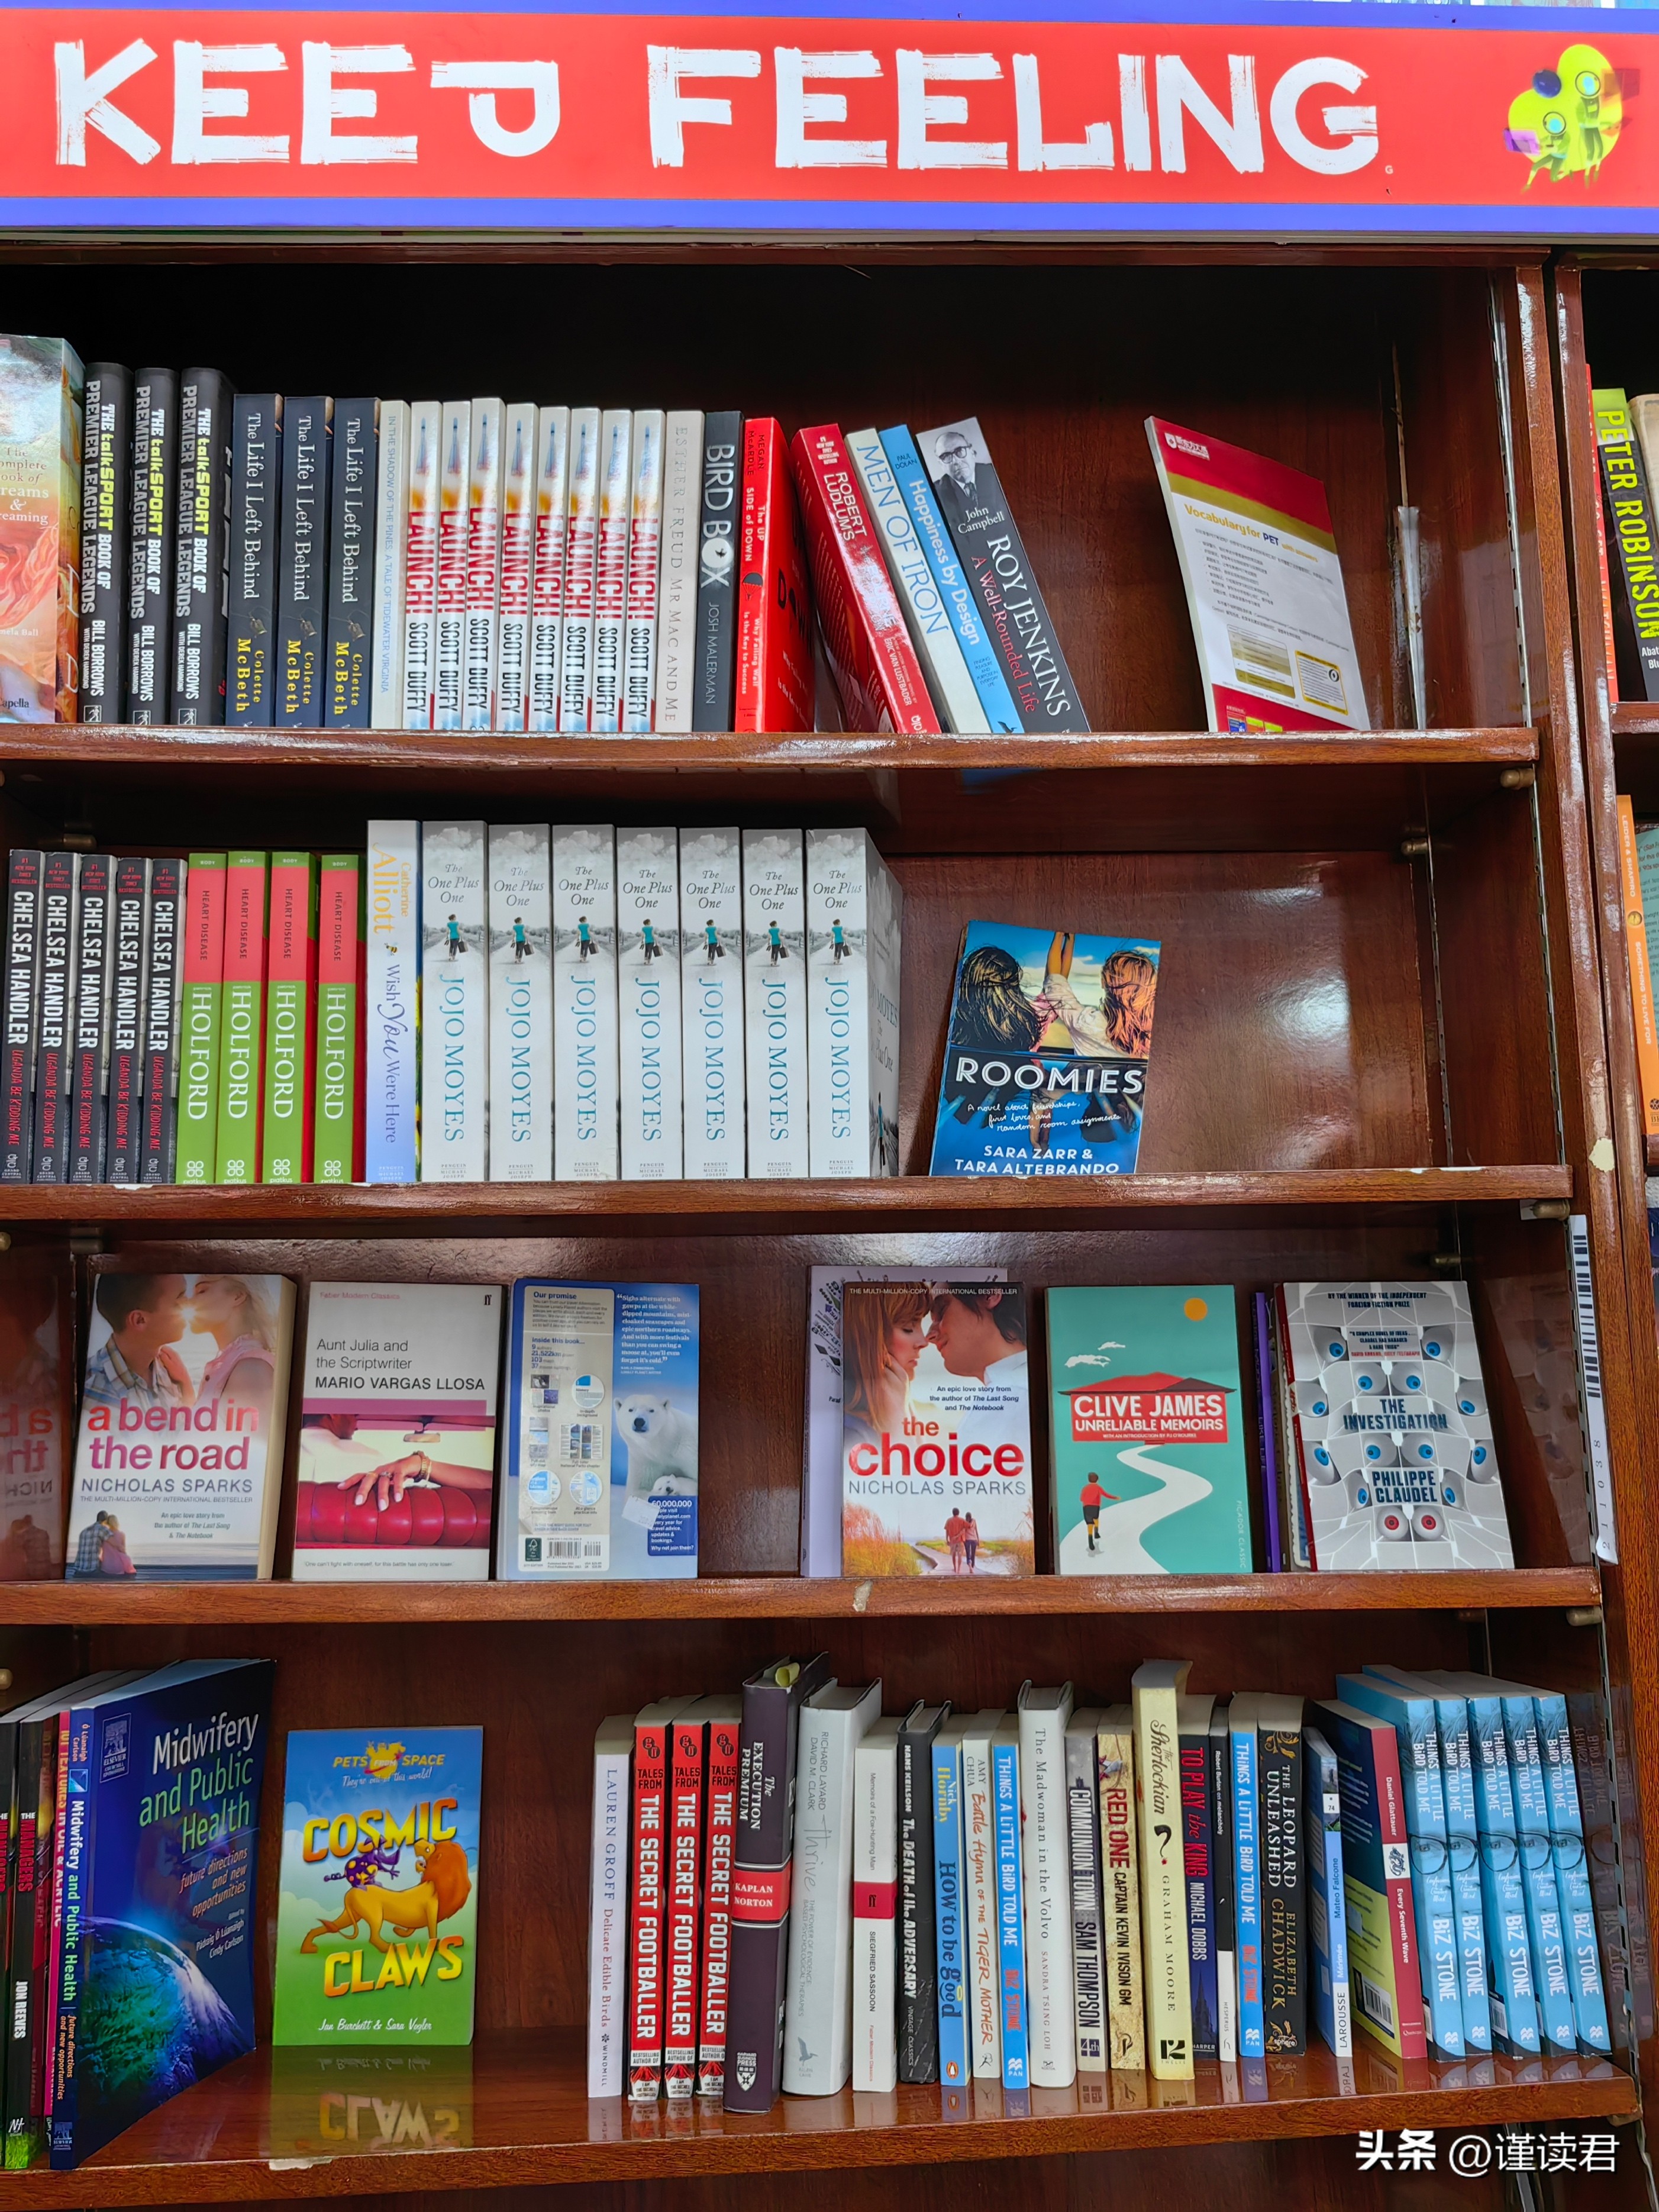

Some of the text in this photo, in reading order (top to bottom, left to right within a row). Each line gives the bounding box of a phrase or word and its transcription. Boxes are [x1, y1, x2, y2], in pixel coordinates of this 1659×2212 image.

[53, 38, 1379, 175] KEEP FEELING
[248, 412, 261, 439] The
[247, 442, 265, 477] Life
[856, 445, 900, 508] MEN
[81, 380, 101, 614] PREMIER LEAGUE LEGENDS
[97, 404, 115, 590] THE talkSPORT BOOK OF
[245, 495, 264, 534] Left
[700, 444, 734, 588] BIRD BOX
[1184, 504, 1279, 546] Vocabulary for PET
[1597, 410, 1659, 639] PETER ROBINSON
[467, 508, 496, 611] LAUNCH!
[886, 515, 918, 553] OF
[908, 479, 979, 645] Happiness by Design
[243, 539, 261, 600] Behind
[901, 561, 949, 635] IRON
[706, 601, 719, 704] JOSH MALERMAN
[971, 556, 987, 570] A
[979, 572, 1024, 680] Well-Rounded
[1016, 681, 1036, 712] Life
[986, 535, 1071, 716] ROY JENKINS
[469, 618, 489, 709] SCOTT DUFFY
[559, 879, 609, 891] One Plus
[571, 894, 595, 905] One
[575, 866, 592, 876] The
[12, 891, 34, 965] CHELSEA
[8, 969, 31, 1045] HANDLER
[229, 989, 252, 1120] HOLFORD
[377, 964, 408, 1143] Wish You Were Here
[571, 976, 596, 1140] JOJO MOYES
[956, 1057, 1142, 1094] ROOMIES
[956, 1159, 1119, 1175] TARA ALTEBRANDO
[984, 1145, 1092, 1159] SARA ZARR &
[317, 1339, 408, 1352] Aunt Julia and
[317, 1357, 412, 1371] the Scriptwriter
[315, 1377, 485, 1389] MARIO VARGAS LLOSA
[1074, 1395, 1222, 1417] CLIVE JAMES
[1380, 1398, 1406, 1413] THE
[88, 1398, 259, 1431] a bend in
[903, 1417, 939, 1436] the
[1075, 1419, 1223, 1431] UNRELIABLE MEMOIRS
[1343, 1413, 1447, 1430] INVESTIGATION
[89, 1436, 250, 1470] the road
[848, 1433, 1024, 1476] choice
[1372, 1471, 1436, 1487] PHILIPPE
[82, 1479, 253, 1492] NICHOLAS SPARKS
[1376, 1487, 1437, 1502] CLAUDEL
[152, 1712, 259, 1775] Midwifery
[138, 1750, 254, 1827] and Public
[182, 1791, 250, 1855] Health
[303, 1798, 457, 1862] COSMIC
[1069, 1789, 1094, 1911] COMMUNION TOWN
[1106, 1787, 1130, 1869] RED ONE
[1267, 1770, 1280, 1887] UNLEASHED
[1282, 1795, 1296, 1889] LEOPARD
[637, 1795, 660, 2039] THE SECRET FOOTBALLER
[734, 1897, 773, 1907] NORTON
[735, 1882, 773, 1893] KAPLAN
[324, 1935, 463, 1997] CLAWS
[1577, 1945, 1600, 1997] STONE
